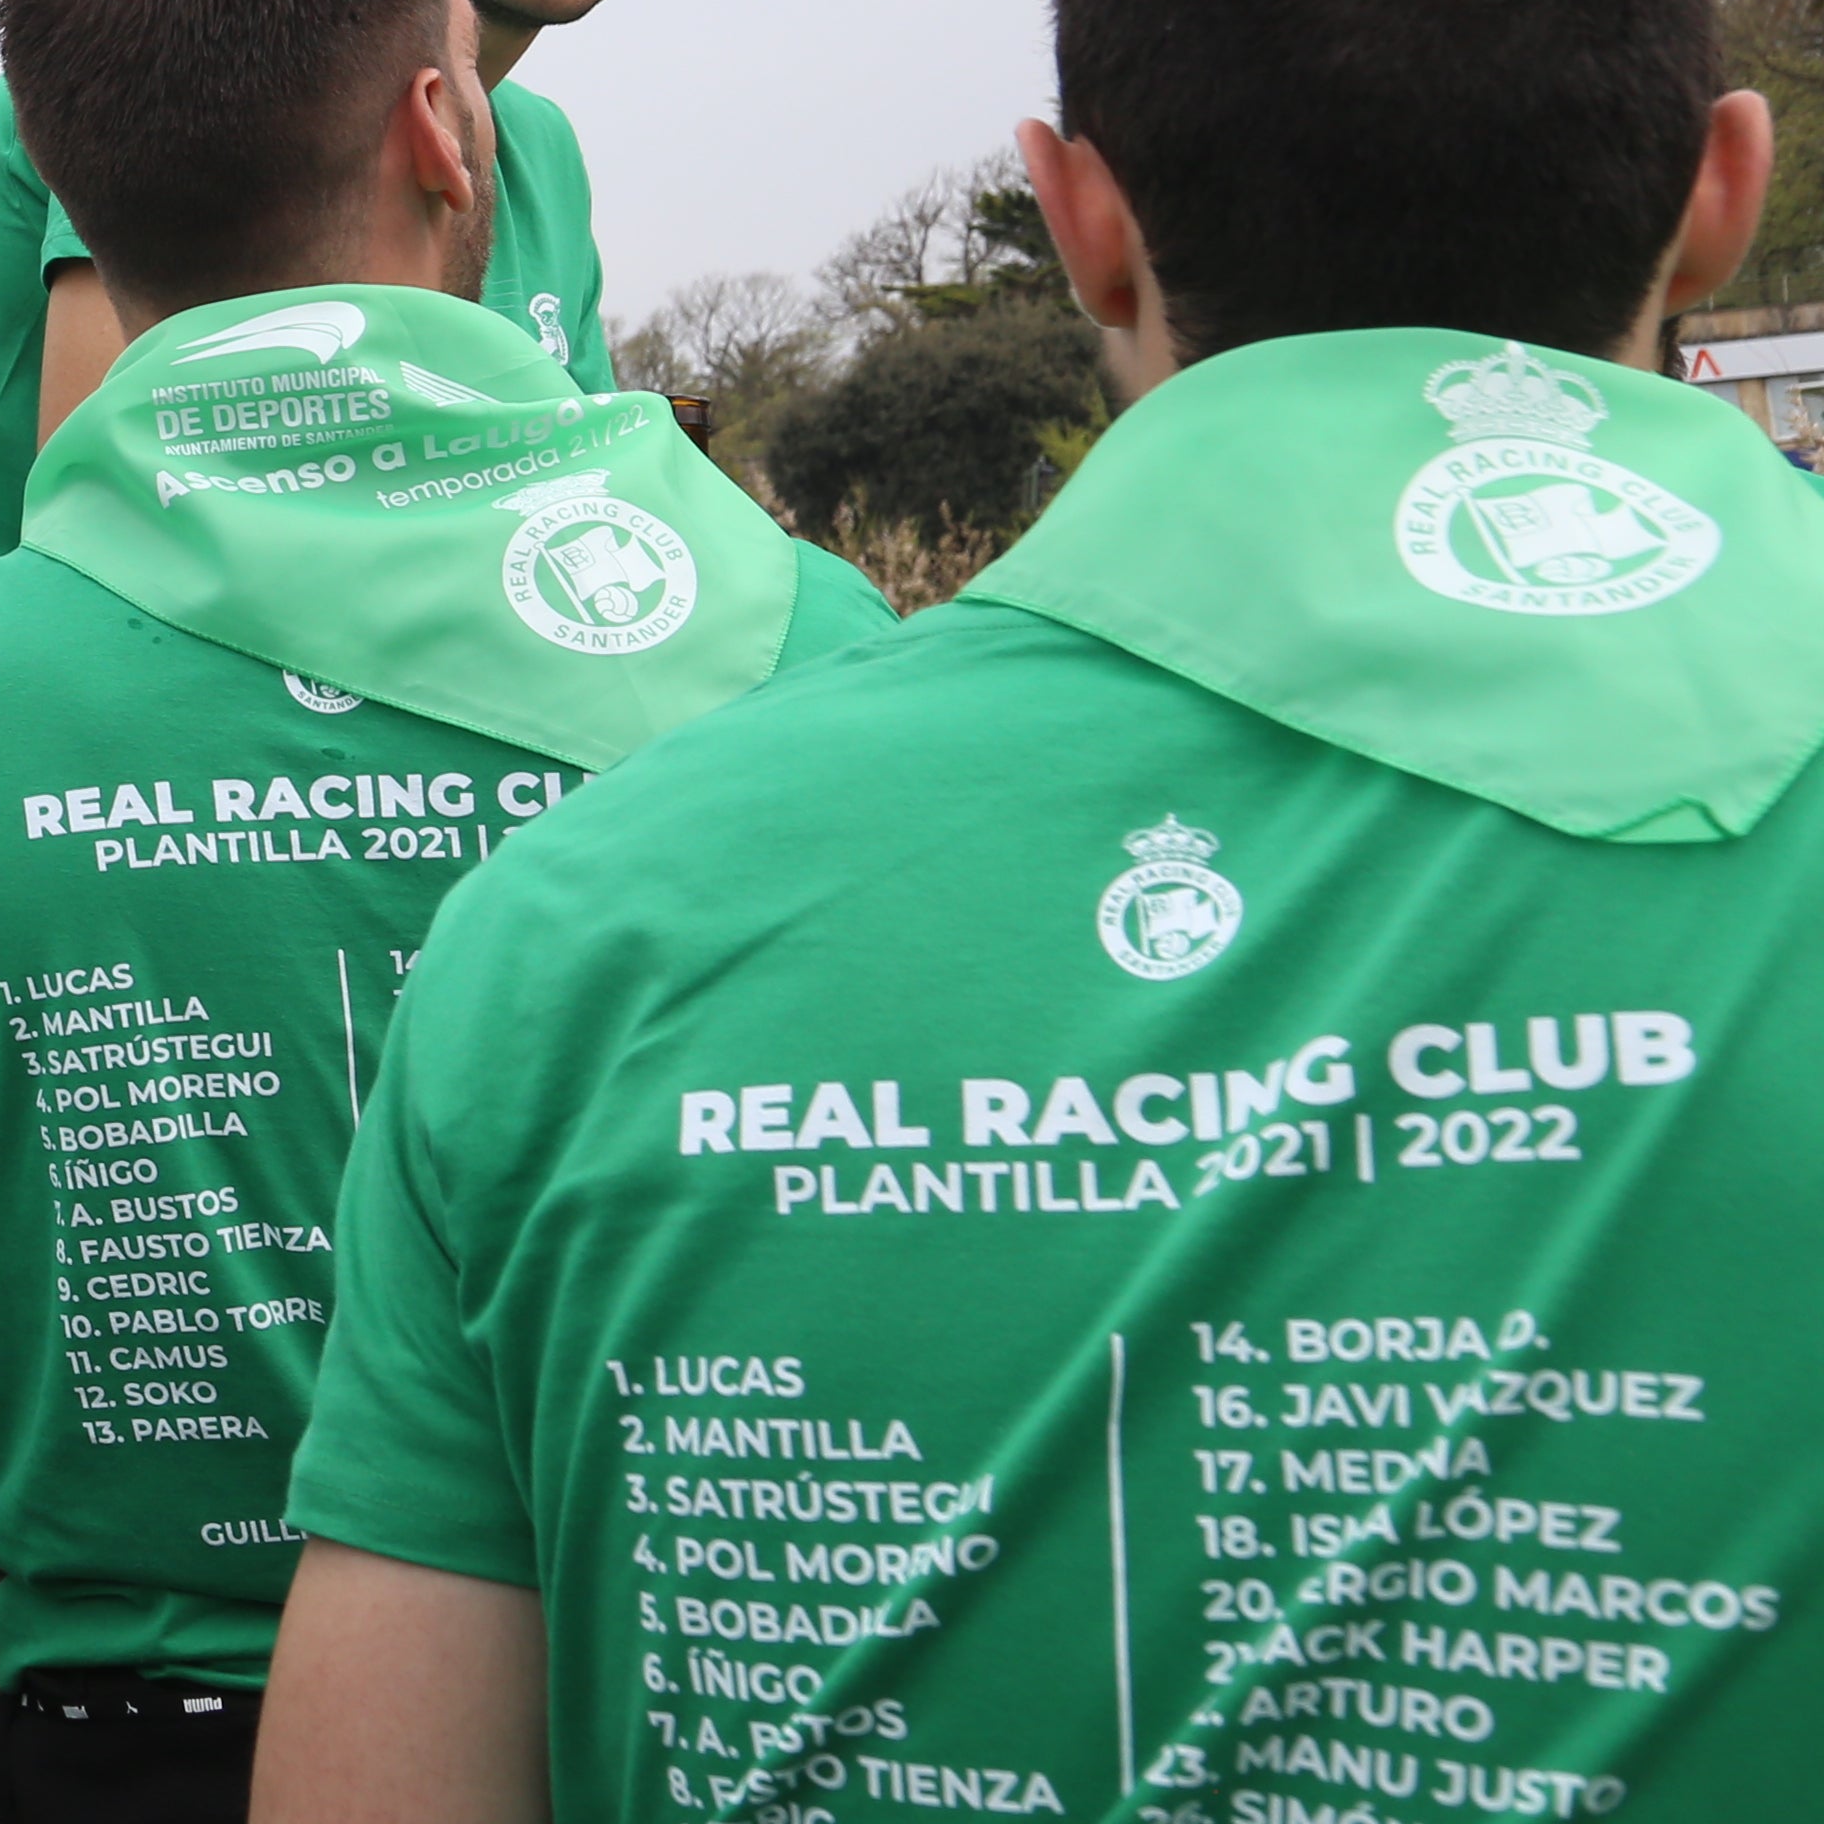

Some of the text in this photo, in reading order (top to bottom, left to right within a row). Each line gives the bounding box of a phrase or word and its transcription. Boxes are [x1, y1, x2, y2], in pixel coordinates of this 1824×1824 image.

[151, 366, 386, 406] INSTITUTO MUNICIPAL
[156, 388, 391, 442] DE DEPORTES
[164, 434, 280, 457] AYUNTAMIENTO
[281, 433, 304, 448] DE
[375, 403, 650, 510] temporada 21/22
[156, 453, 357, 510] Ascenso
[370, 442, 407, 472] a
[1409, 485, 1457, 556] REAL
[1446, 447, 1607, 481] RACING
[511, 501, 685, 604] REAL RACING CLUB
[553, 593, 690, 650] SANTANDER
[295, 688, 359, 713] SANTAND
[23, 772, 475, 840] REAL RACING
[94, 825, 463, 872] PLANTILLA 2021
[678, 1009, 1697, 1156] REAL RACING CLUB
[774, 1103, 1581, 1216] PLANTILLA 2021 2022
[79, 1223, 332, 1266] FAUSTO TIENZA
[57, 1270, 212, 1303] 9. CEDRIC
[60, 1297, 326, 1340] 10. PABLO TORRE
[1191, 1321, 1271, 1364] 14.
[1286, 1317, 1492, 1364] BORJA
[67, 1344, 228, 1375] 11. CAMUS
[606, 1356, 806, 1399] 1. LUCAS
[74, 1381, 218, 1411] 12. SOKO
[83, 1415, 269, 1445] 13. PARERA
[1414, 1485, 1623, 1553] LÓPEZ
[1493, 1564, 1780, 1632] MARCOS
[1400, 1621, 1669, 1694] HARPER
[857, 1754, 1065, 1815] TIENZA
